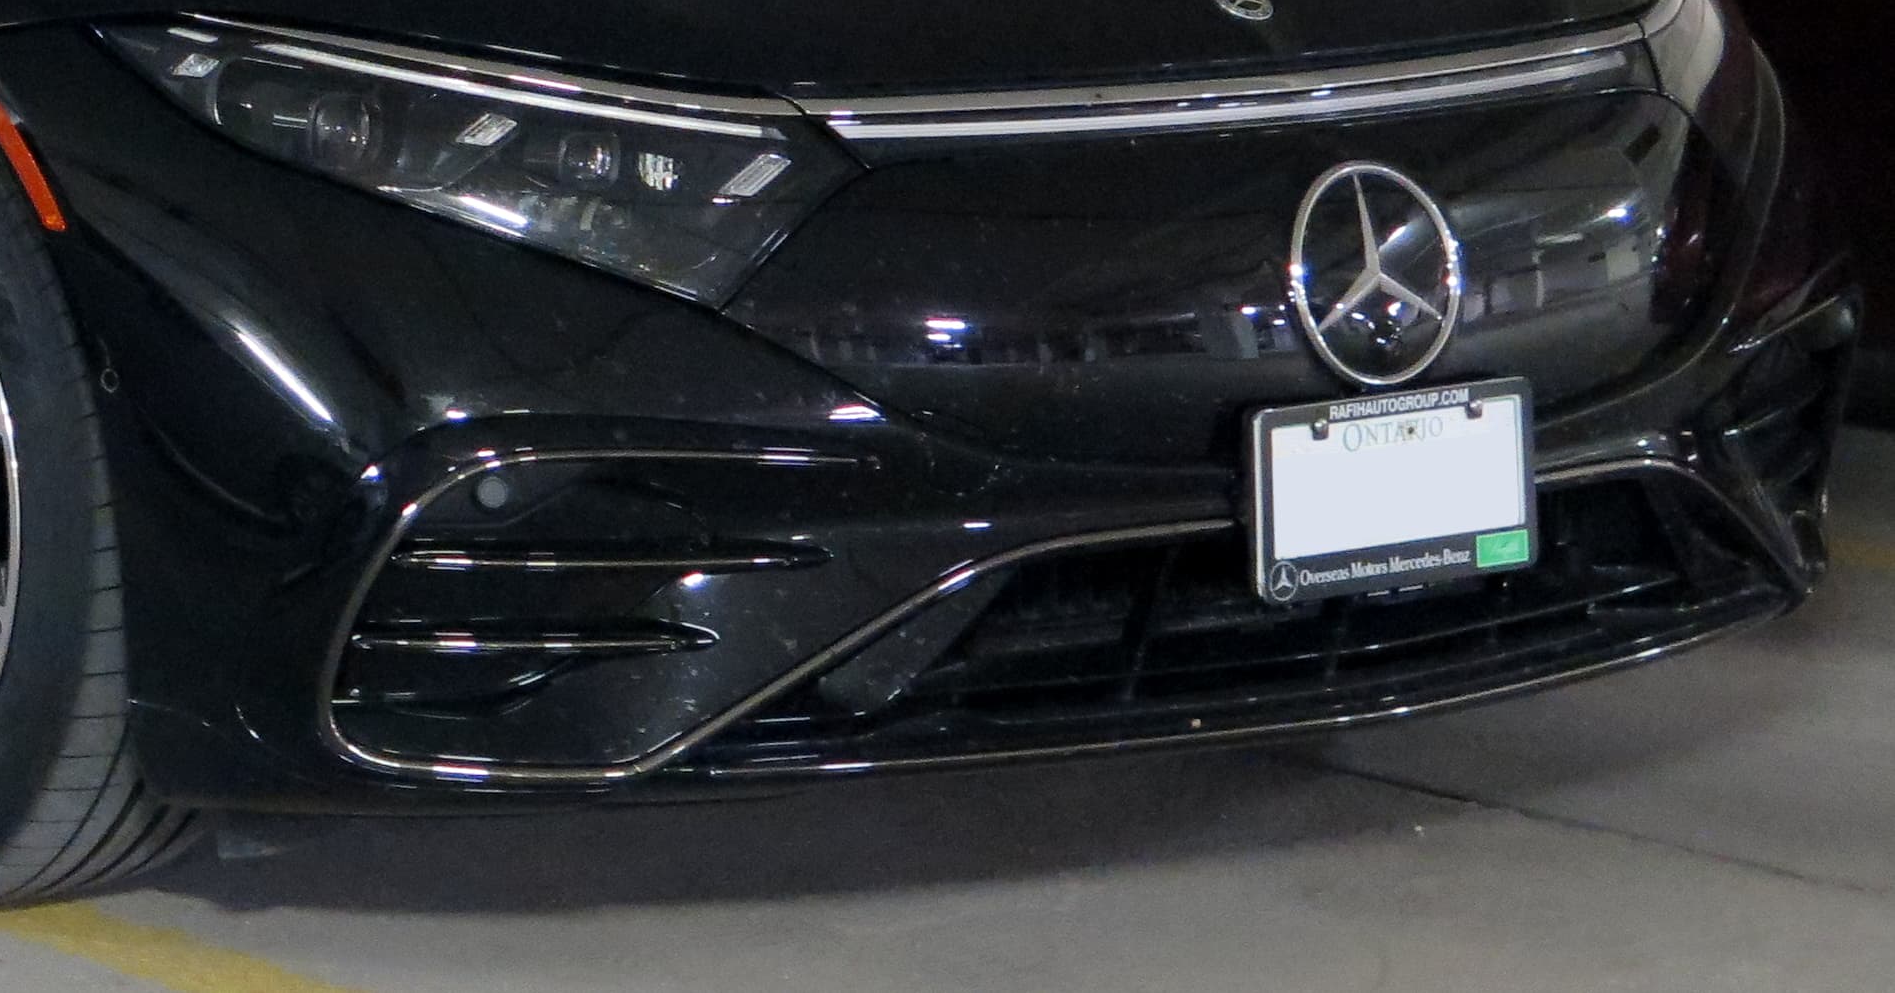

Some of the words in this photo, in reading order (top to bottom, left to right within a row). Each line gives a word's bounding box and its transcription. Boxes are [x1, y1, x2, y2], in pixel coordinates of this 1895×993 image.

[1329, 388, 1469, 420] RAFIHAUTOGROUP.COM
[1299, 567, 1350, 586] Overseas
[1351, 561, 1388, 579] Motors
[1389, 548, 1471, 574] Mercedes-Benz
